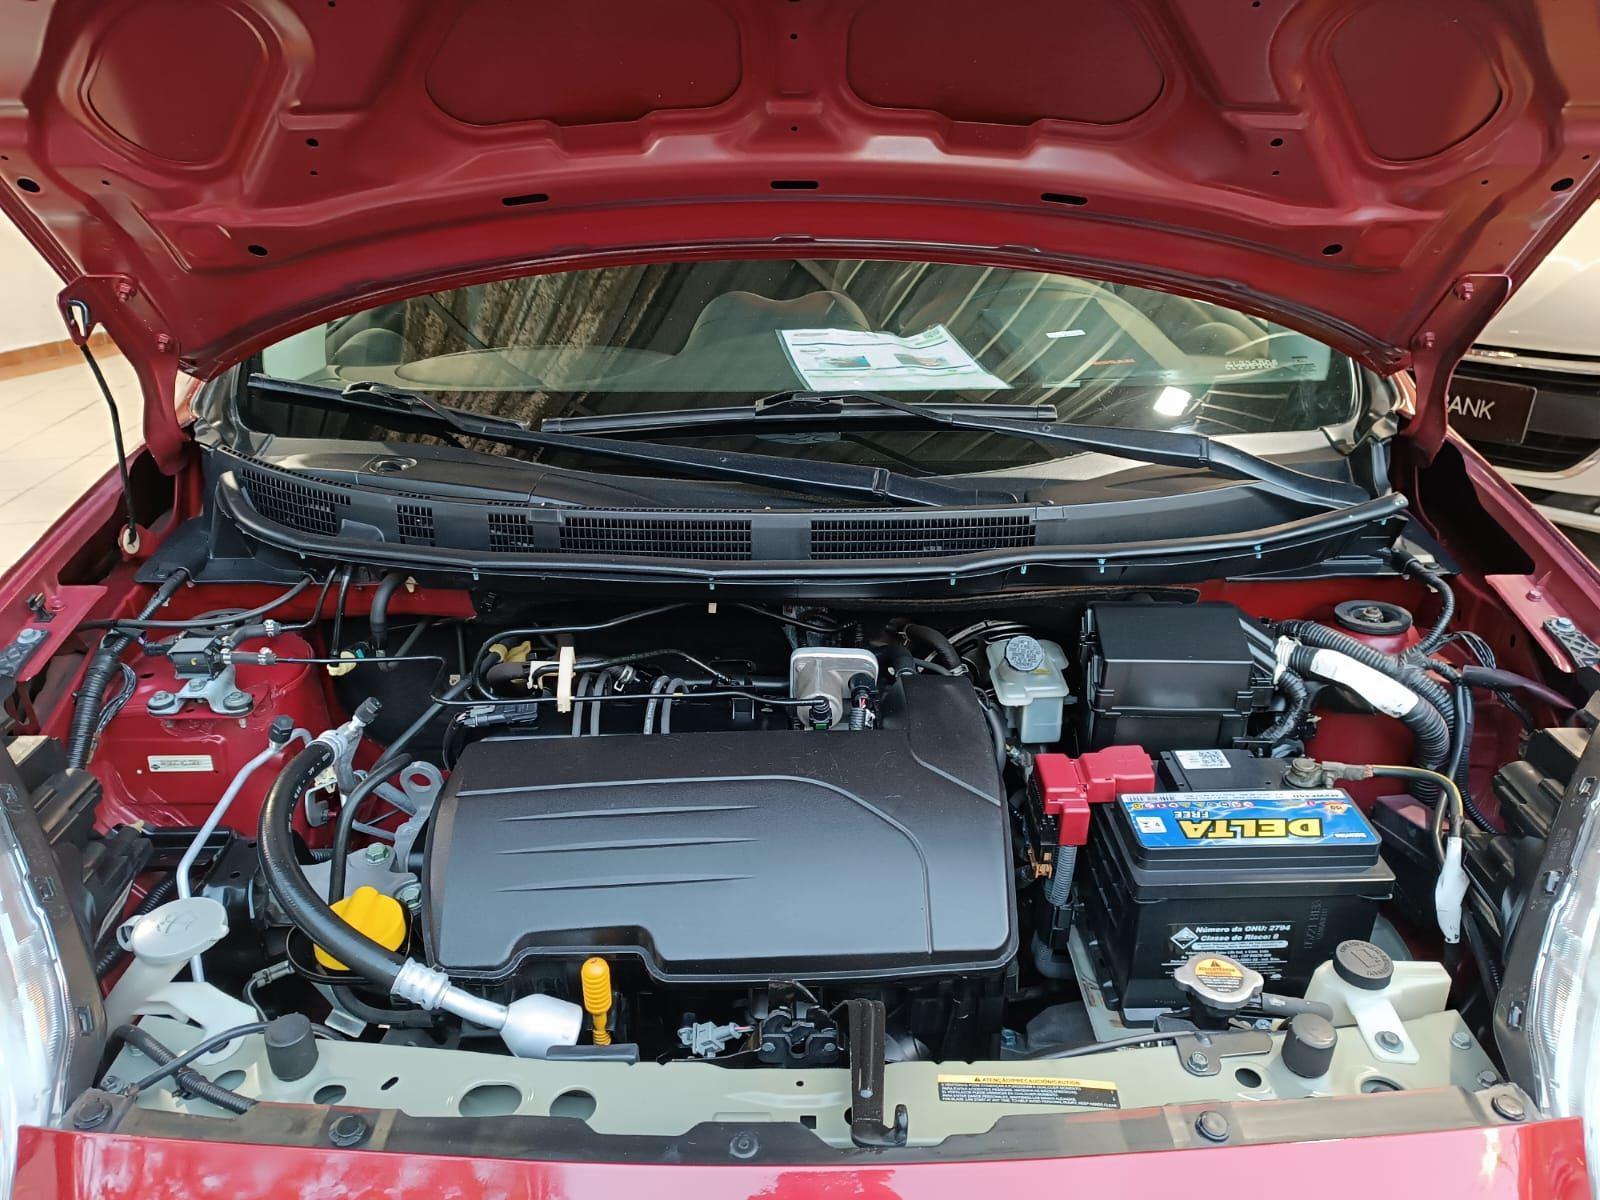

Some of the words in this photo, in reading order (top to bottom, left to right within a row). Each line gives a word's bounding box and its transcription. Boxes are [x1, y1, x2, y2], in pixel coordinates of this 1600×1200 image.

[1447, 395, 1496, 420] ANK
[1173, 810, 1209, 819] FREE
[1177, 817, 1323, 839] DELTA
[1195, 926, 1230, 934] Número
[1200, 934, 1228, 942] Classe
[1230, 933, 1243, 941] de
[1244, 933, 1271, 941] Risco:
